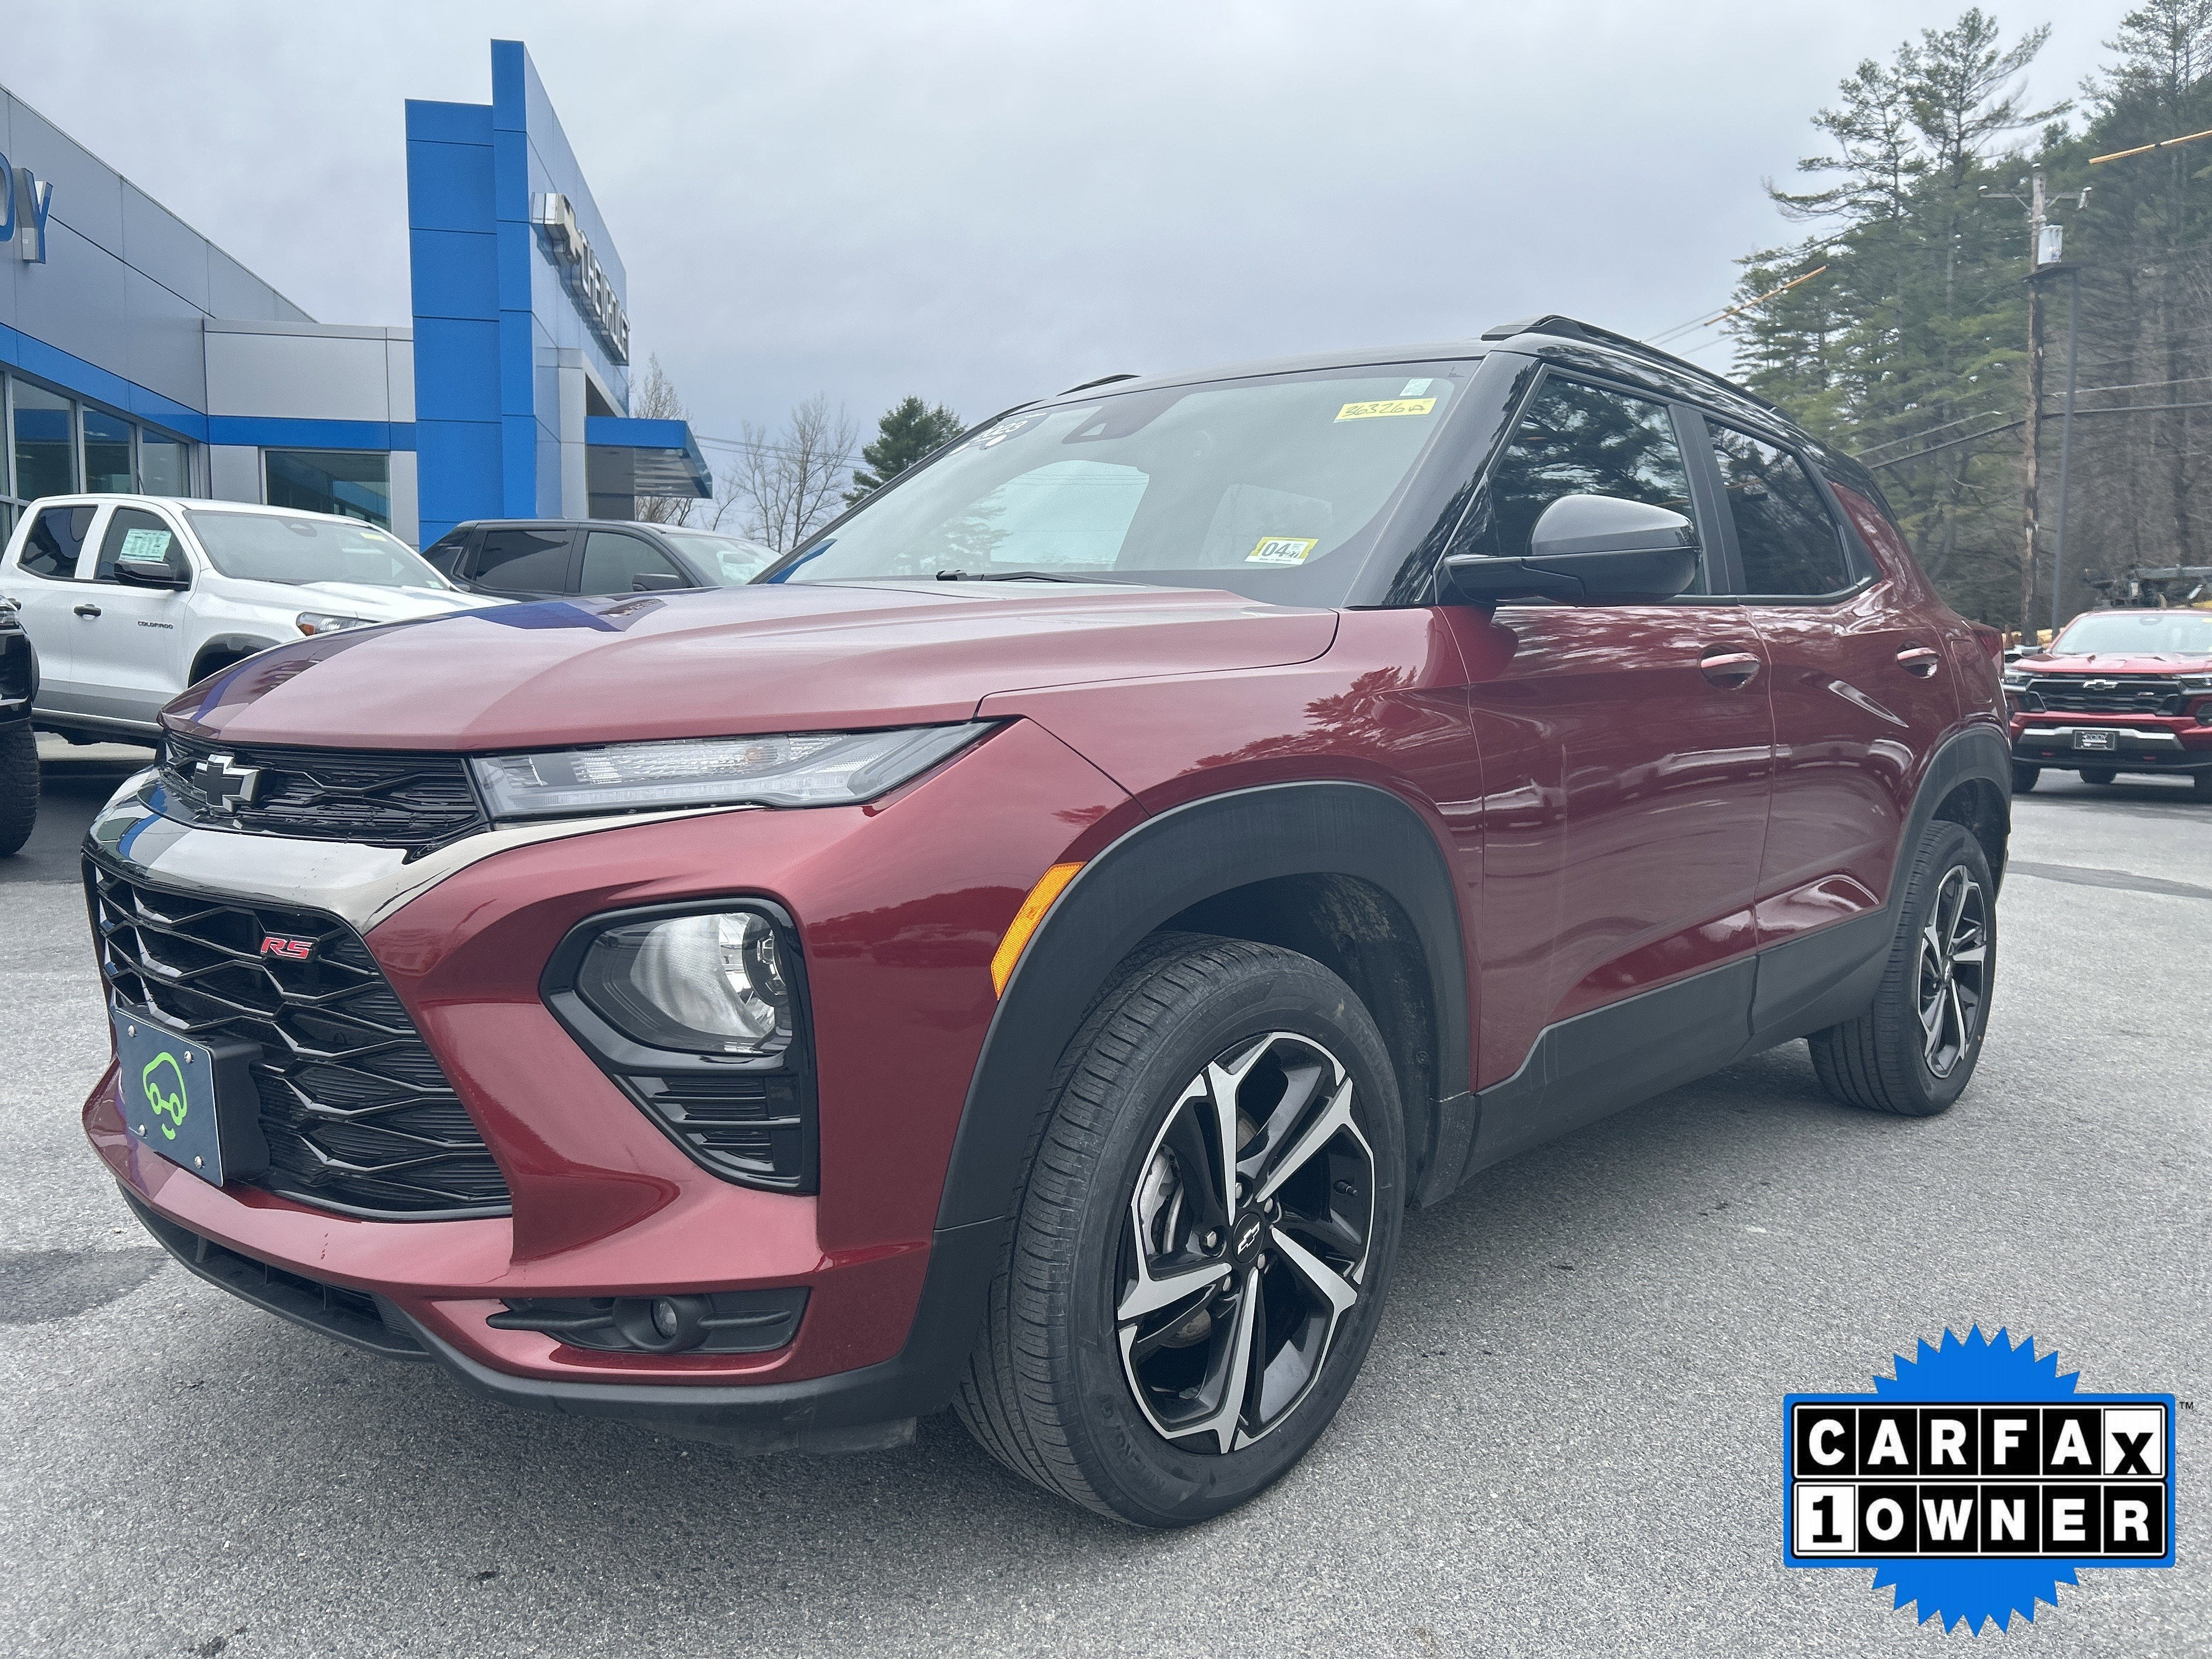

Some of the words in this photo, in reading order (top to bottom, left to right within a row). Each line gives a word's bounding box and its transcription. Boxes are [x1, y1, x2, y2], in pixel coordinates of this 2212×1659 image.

[1262, 543, 1291, 556] 04
[138, 621, 173, 629] COLORADO
[261, 936, 312, 959] RS
